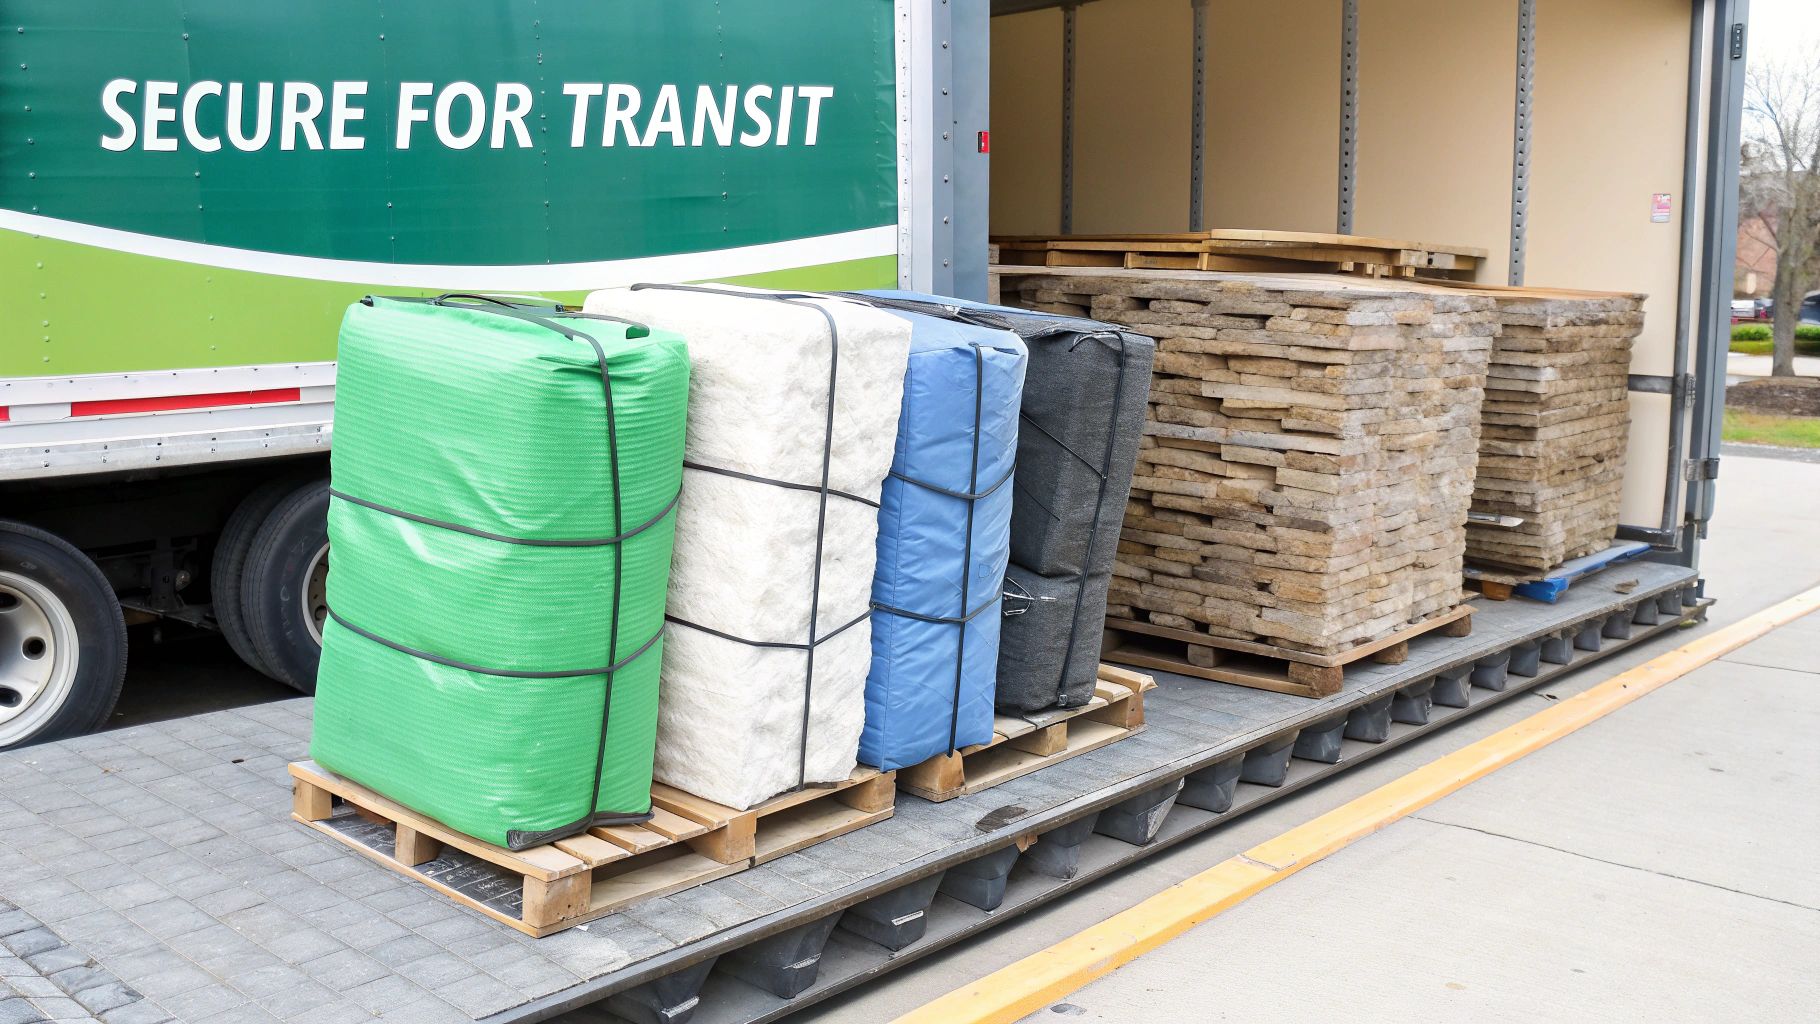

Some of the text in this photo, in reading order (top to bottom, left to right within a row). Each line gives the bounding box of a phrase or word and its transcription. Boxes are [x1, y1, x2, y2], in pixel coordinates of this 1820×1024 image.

[101, 78, 834, 152] SECURE FOR TRANSIT
